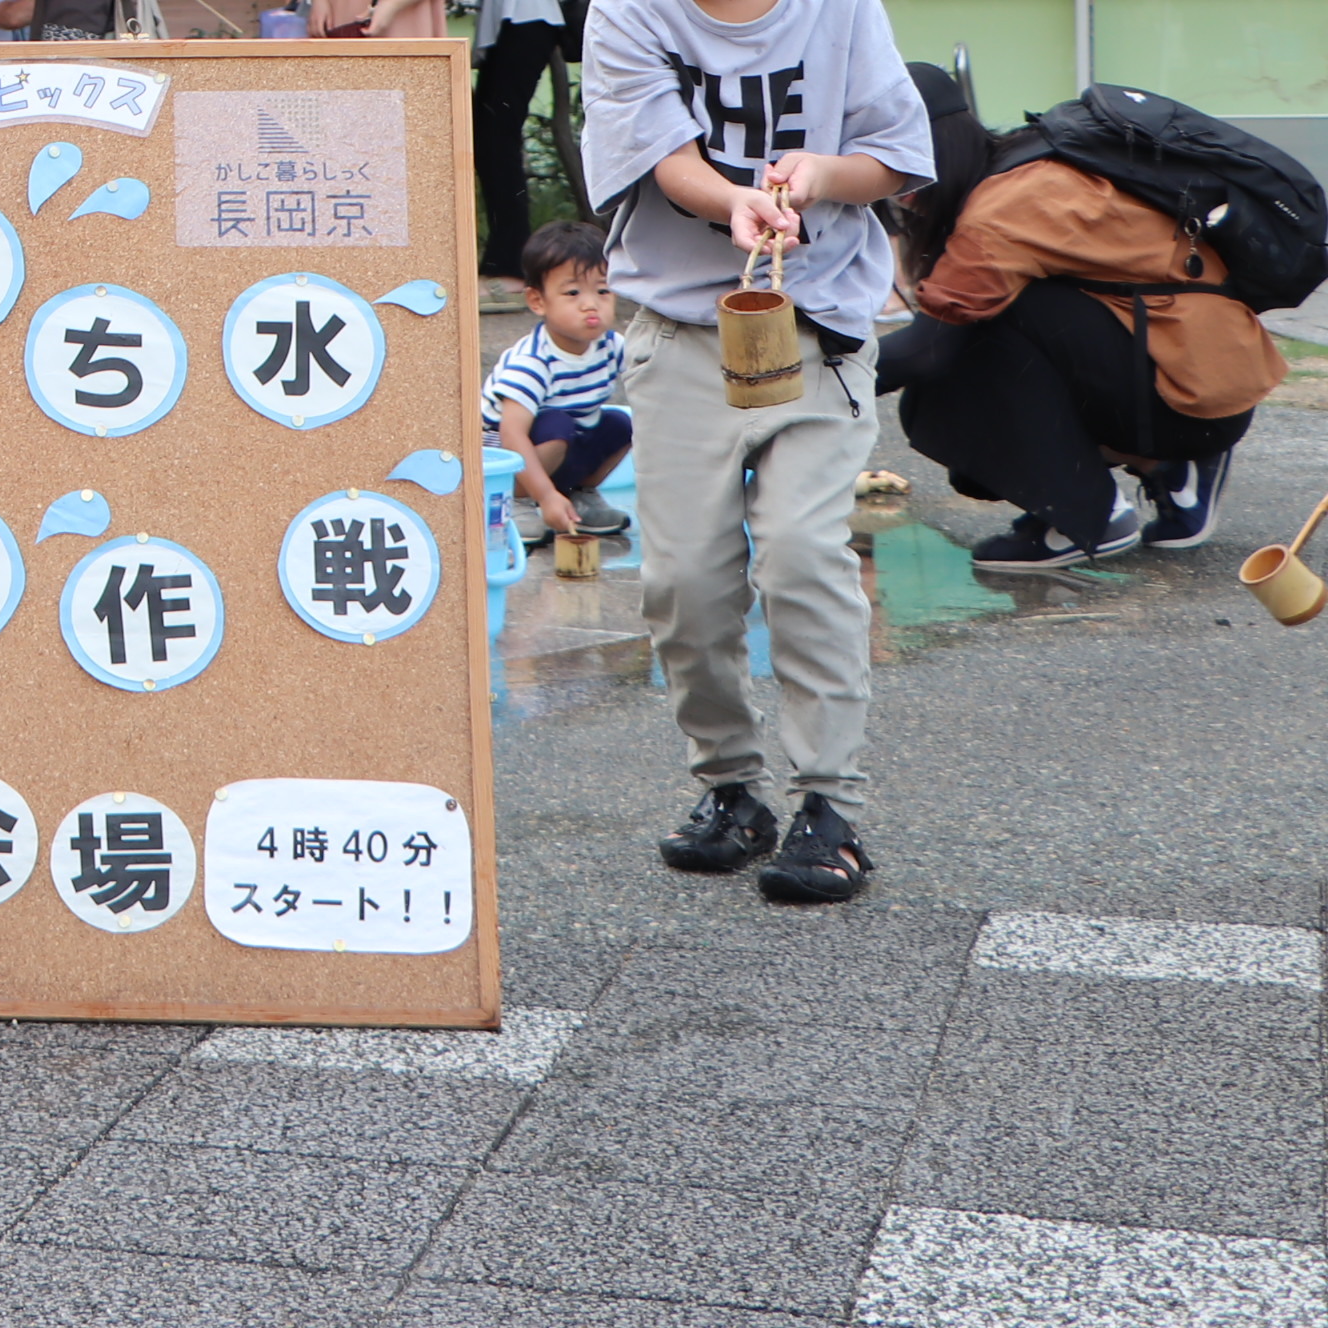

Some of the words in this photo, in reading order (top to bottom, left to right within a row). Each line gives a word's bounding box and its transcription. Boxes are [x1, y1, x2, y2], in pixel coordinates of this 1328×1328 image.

[215, 160, 371, 182] かしこ暮らしっく
[210, 188, 374, 238] 長岡京
[257, 826, 439, 867] 4時40分
